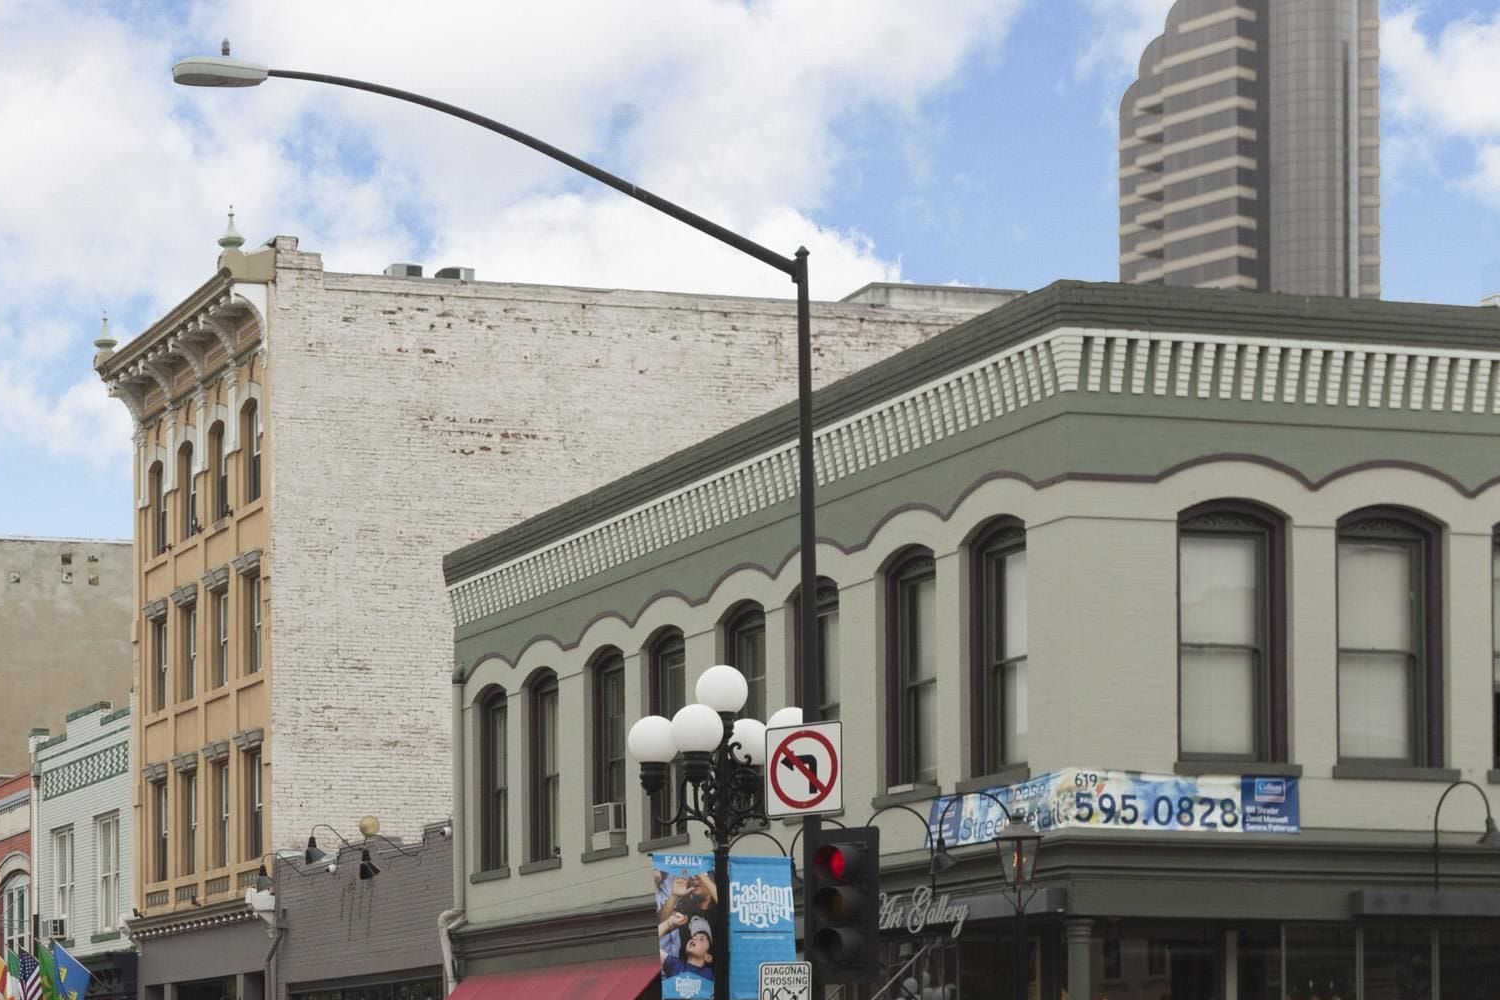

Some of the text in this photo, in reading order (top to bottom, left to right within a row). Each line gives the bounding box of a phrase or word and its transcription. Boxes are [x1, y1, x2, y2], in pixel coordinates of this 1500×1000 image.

[1075, 773, 1097, 788] 619
[1075, 793, 1238, 828] 595.0828
[961, 816, 1004, 841] Stree
[664, 855, 704, 866] FAMILY
[729, 877, 794, 913] Gaslamp
[907, 885, 969, 938] Gallery
[764, 967, 807, 976] DIAGONAL
[764, 977, 807, 986] CROSSING
